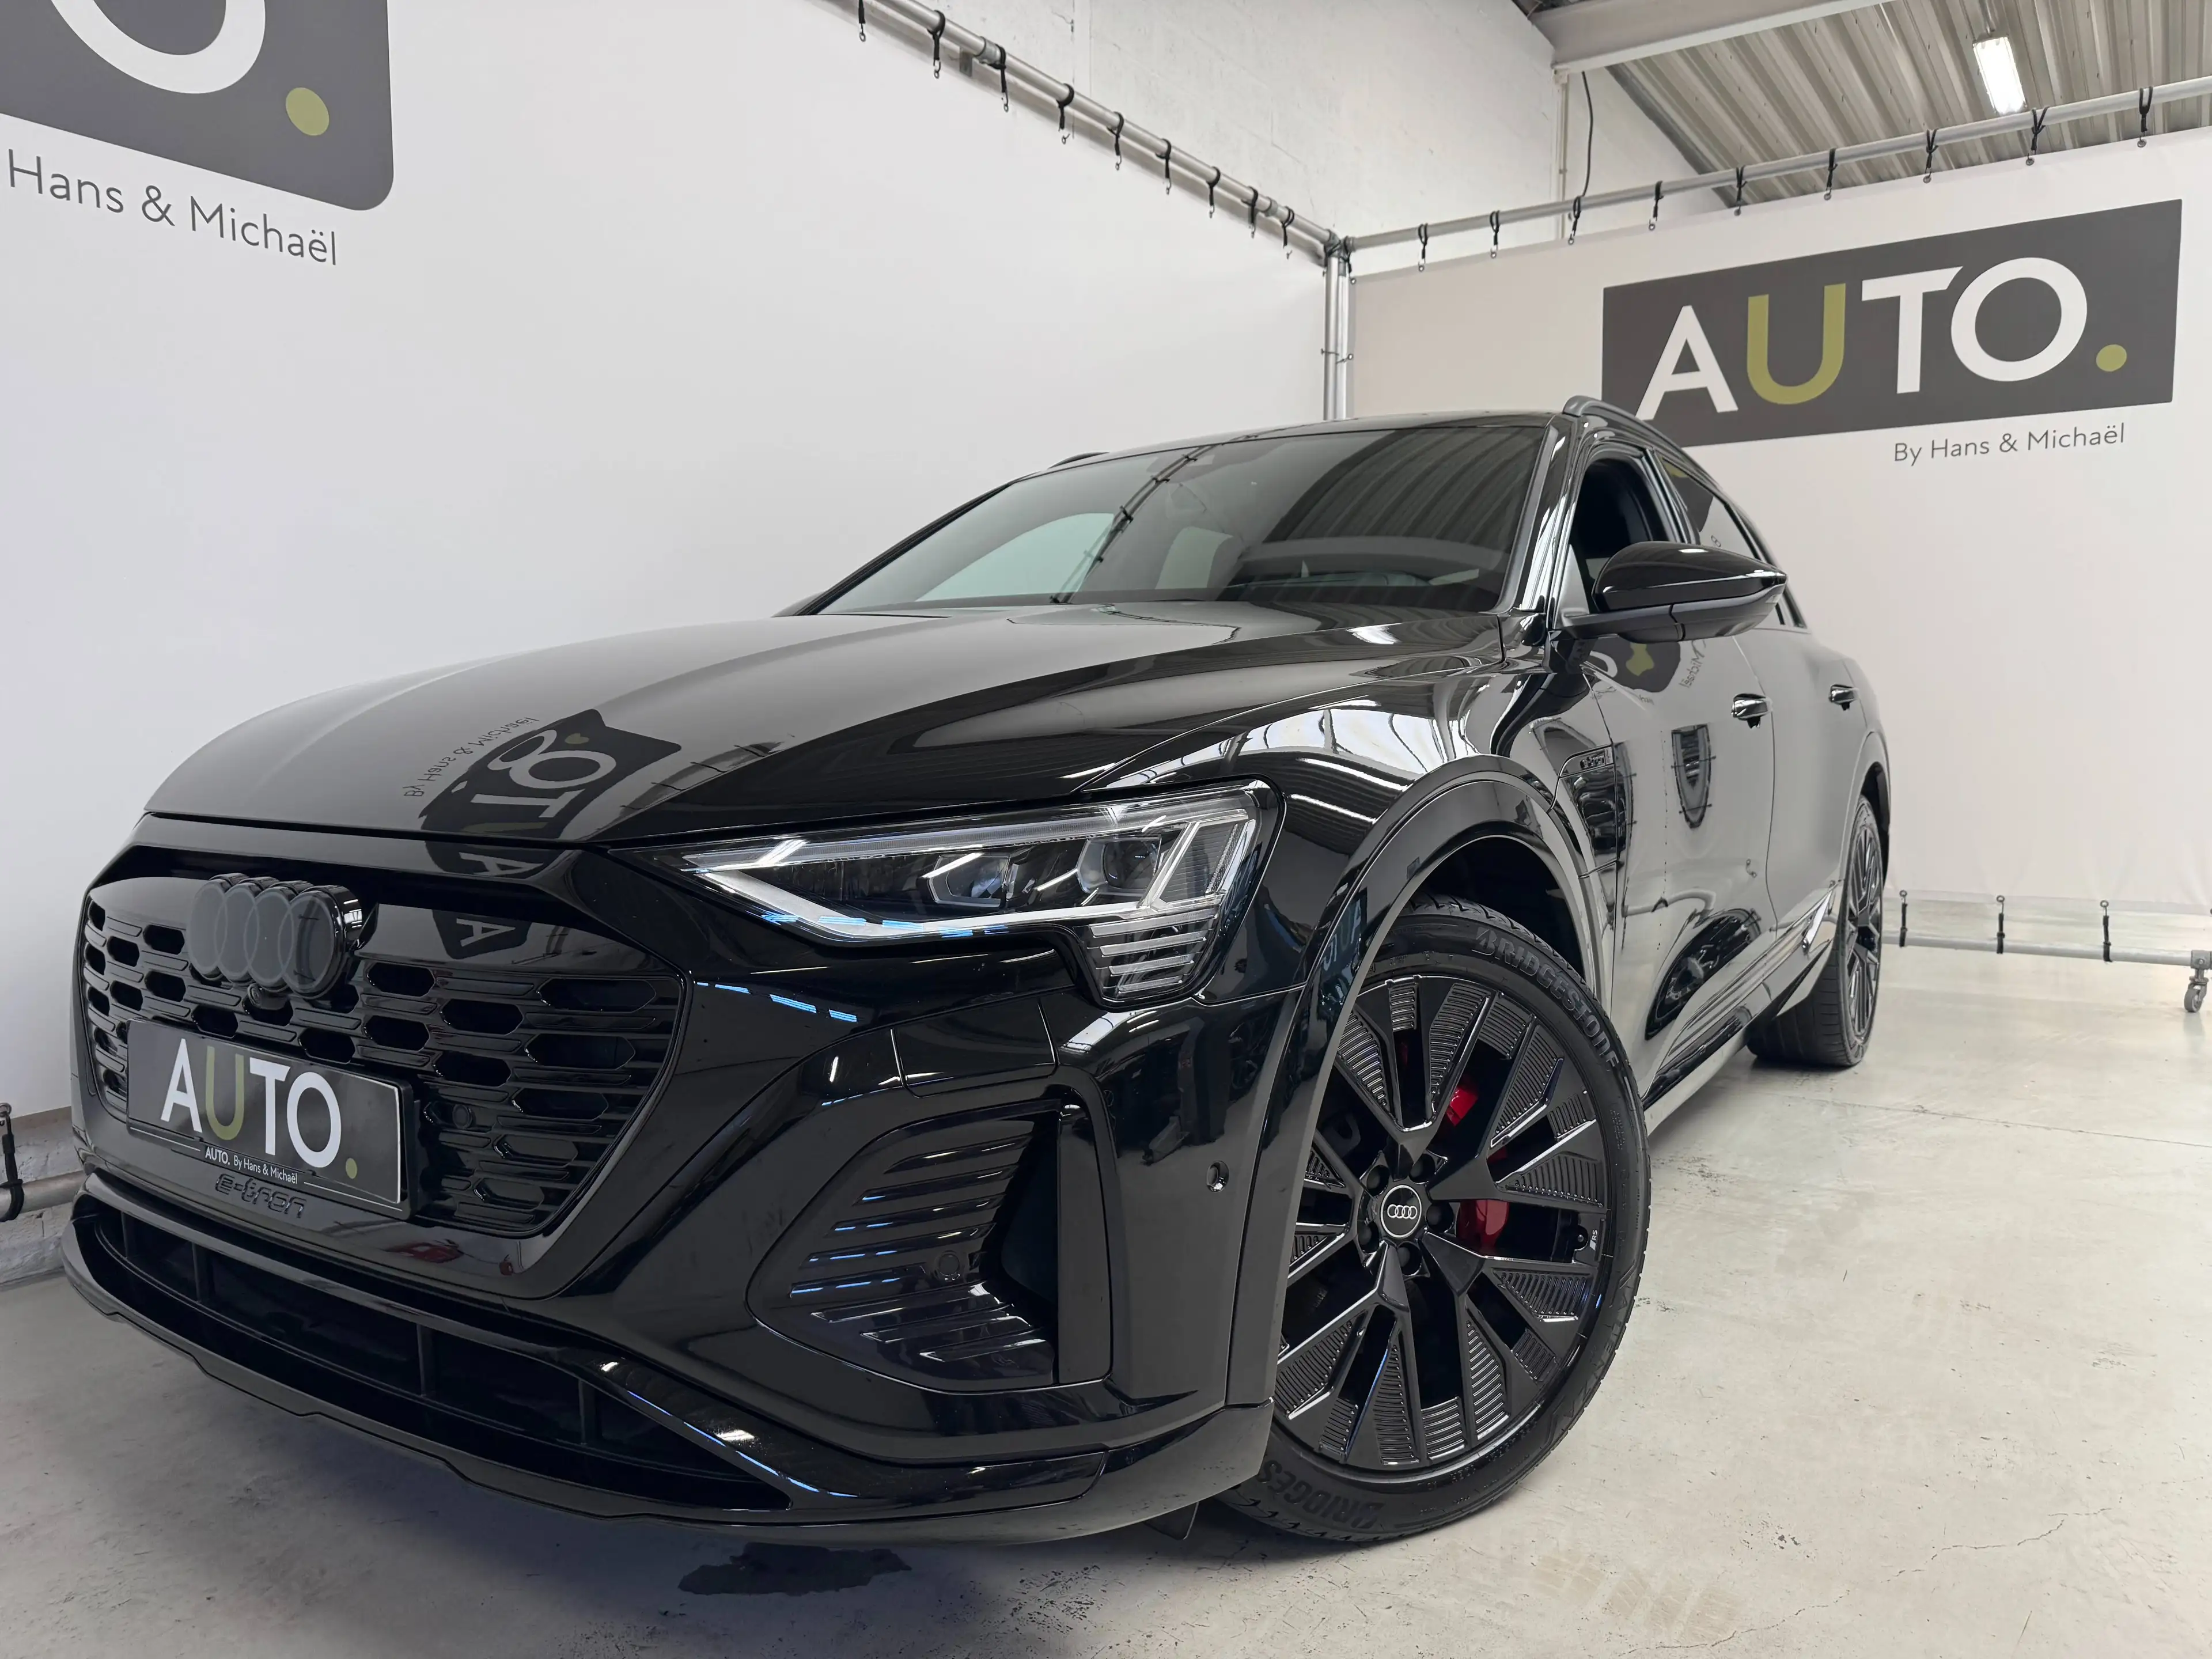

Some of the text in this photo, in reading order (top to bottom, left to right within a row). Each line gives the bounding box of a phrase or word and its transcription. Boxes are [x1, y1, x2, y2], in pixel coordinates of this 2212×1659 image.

[8, 149, 337, 266] Hans & Michaël
[1635, 256, 2127, 421] AUTO.
[1894, 422, 2124, 467] By Hans & Michaël
[1471, 926, 1620, 1072] BRIDGESTONE
[161, 1038, 358, 1179] AUTO.
[205, 1146, 298, 1184] AUTO. By Hans & Michaël
[215, 1173, 307, 1219] e-tron
